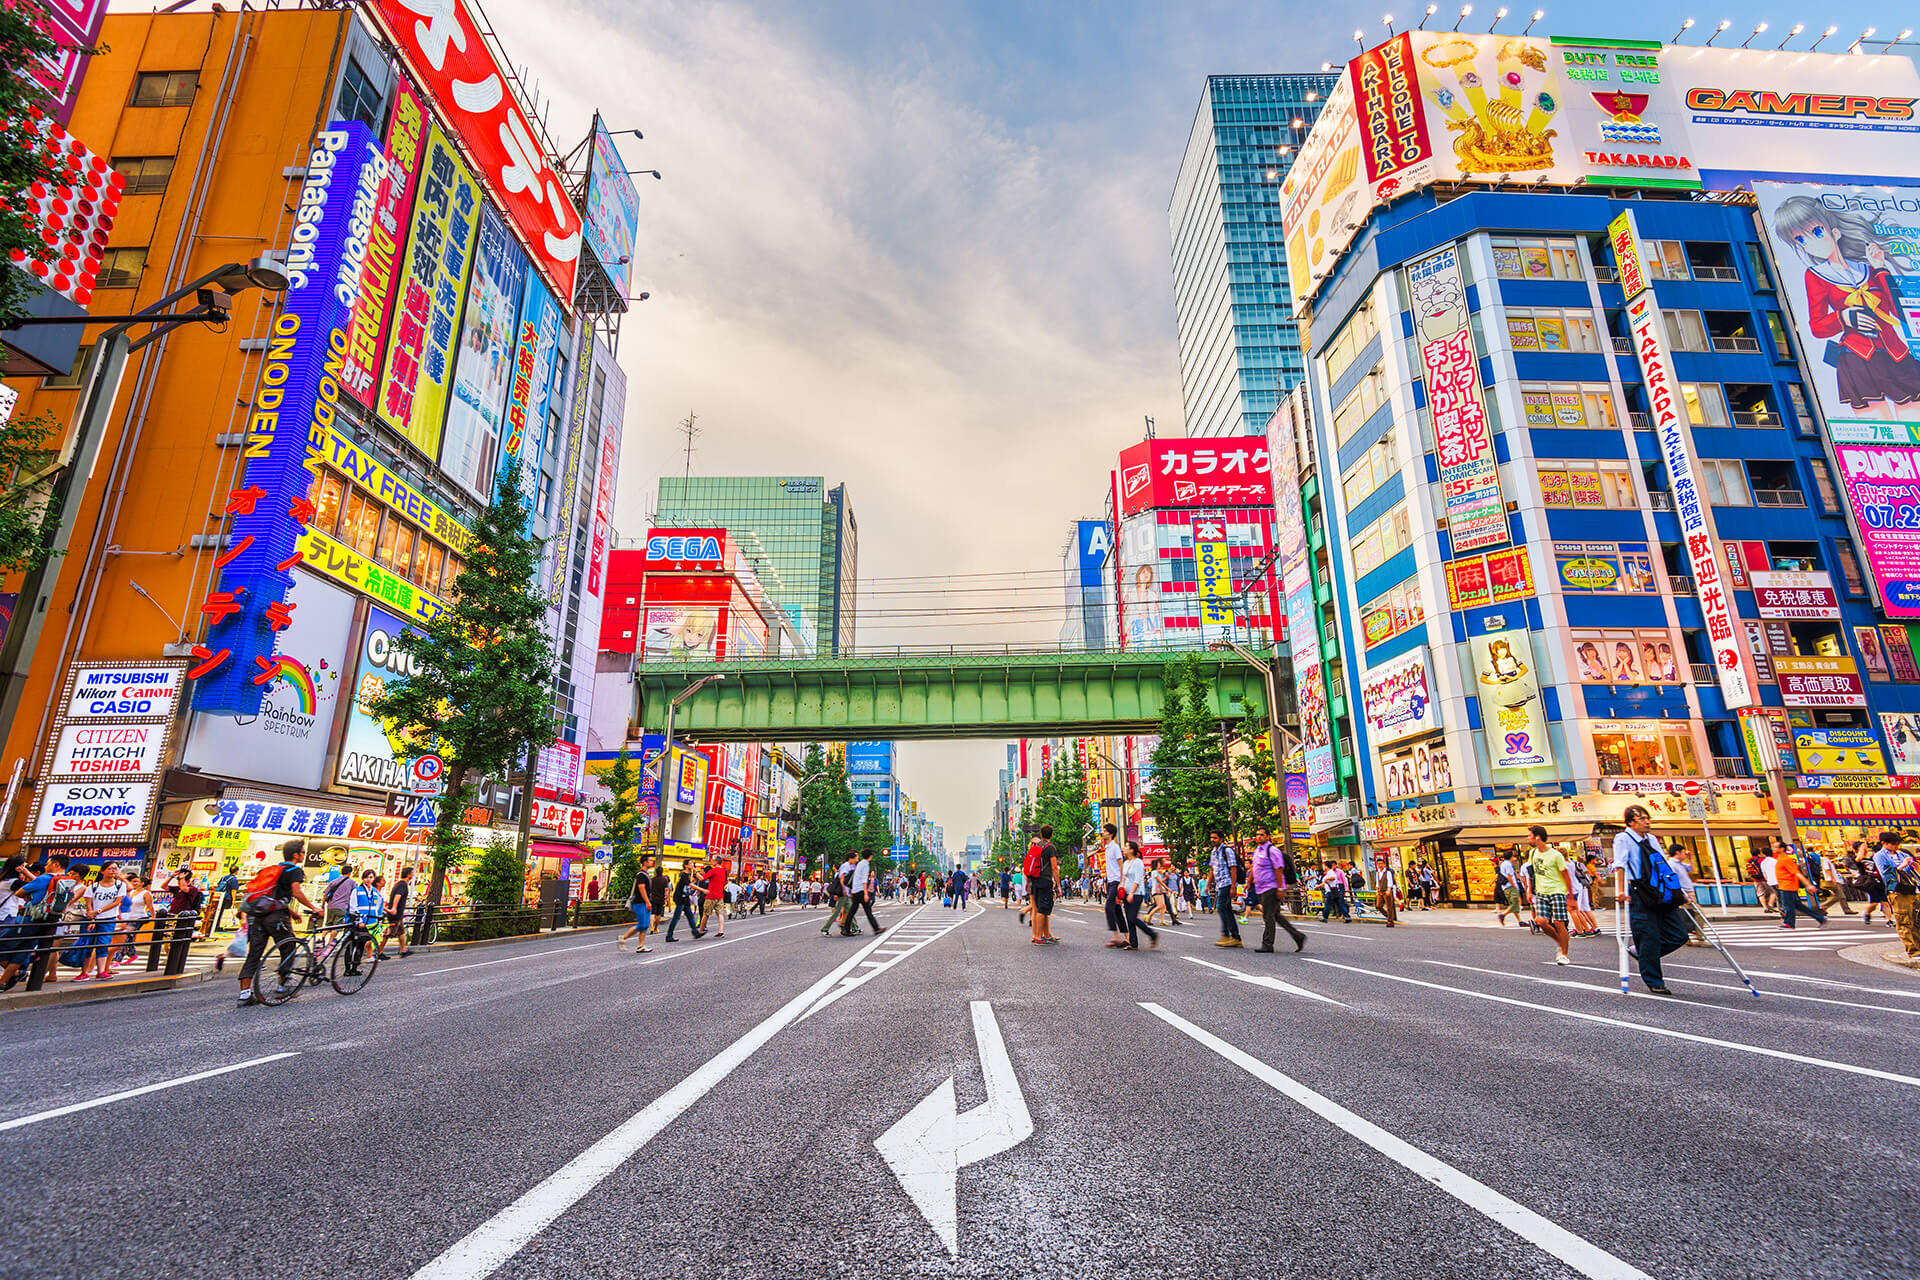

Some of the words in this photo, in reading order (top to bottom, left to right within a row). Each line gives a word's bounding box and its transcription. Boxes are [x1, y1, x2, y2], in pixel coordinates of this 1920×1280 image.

[1562, 51, 1607, 66] DUTY
[1615, 54, 1659, 69] FREE
[1380, 38, 1413, 132] WELCOME
[1401, 133, 1420, 162] TO
[1685, 87, 1920, 121] GAMERS
[1362, 61, 1396, 176] AKIHABARA
[390, 91, 422, 174] 免税
[1584, 150, 1692, 169] TAKARADA
[1285, 112, 1357, 229] TAKARADA
[287, 130, 350, 289] Panasonic
[334, 142, 390, 308] Panasonic
[1494, 250, 1519, 260] ネット
[1614, 230, 1643, 297] まんが喫茶
[1410, 259, 1455, 284] 秋葉原店
[341, 357, 374, 395] B1F
[1636, 322, 1677, 427] TAKARADA
[244, 313, 301, 458] ONODEN
[1449, 329, 1488, 460] インターネット
[302, 327, 348, 477] ONODEN
[1423, 338, 1468, 467] まんが喫茶
[1524, 396, 1548, 406] INTE
[1554, 396, 1579, 406] RNET
[1527, 413, 1554, 424] COMICS
[1869, 425, 1895, 440] 7階
[1160, 448, 1272, 476] カラオケ
[1441, 460, 1484, 477] INTERNET
[1841, 449, 1918, 480] PUNCH
[329, 433, 379, 489] TAX
[379, 472, 433, 529] FREE
[1443, 469, 1479, 483] COMICS
[1478, 465, 1495, 475] CAFE
[1540, 473, 1567, 488] インター
[1571, 474, 1599, 488] ネット
[1198, 484, 1265, 496] アドアーズ
[1543, 490, 1571, 504] まんが
[1575, 490, 1601, 504] 喫茶
[1674, 477, 1703, 532] 免税商店
[1860, 494, 1889, 505] DVD
[646, 536, 723, 561] SEGA
[1455, 532, 1507, 550] 24時間営業
[187, 484, 267, 680] オノデン
[307, 536, 363, 584] テレビ
[364, 565, 414, 610] 冷蔵庫
[1458, 566, 1485, 588] 麻
[1491, 560, 1519, 582] 雀
[253, 495, 317, 685] オノデン
[1459, 588, 1488, 600] ウェル
[1493, 583, 1514, 594] カム
[1782, 609, 1821, 617] TAKARADA
[1775, 660, 1788, 670] B1
[87, 672, 169, 685] MITSUBISHI
[1787, 675, 1853, 693] 高価買取
[75, 687, 117, 700] Nikon
[121, 686, 174, 699] Canon
[1806, 695, 1847, 705] TAKARADA
[89, 700, 152, 714] CASIO
[263, 700, 315, 729] Rainbow
[75, 728, 149, 745] CITIZEN
[263, 722, 310, 740] SPECTRUM
[1827, 736, 1875, 744] COMPUTERS
[1828, 730, 1868, 738] DISCOUNT
[1799, 738, 1812, 746] 2F
[71, 746, 146, 759] HITACHI
[69, 759, 141, 773] TOSHIBA
[1807, 776, 1820, 787] 2F
[1834, 775, 1873, 783] DISCOUNT
[1889, 777, 1902, 787] 2F
[67, 787, 132, 800] SONY
[1090, 776, 1098, 801] DVD
[52, 802, 136, 817] Panasonic
[1418, 806, 1446, 824] 富士そば
[1503, 799, 1561, 818] 富士そば
[1831, 797, 1918, 815] TAKARADA
[52, 819, 130, 832] SHARP
[47, 847, 100, 858] WELCOME
